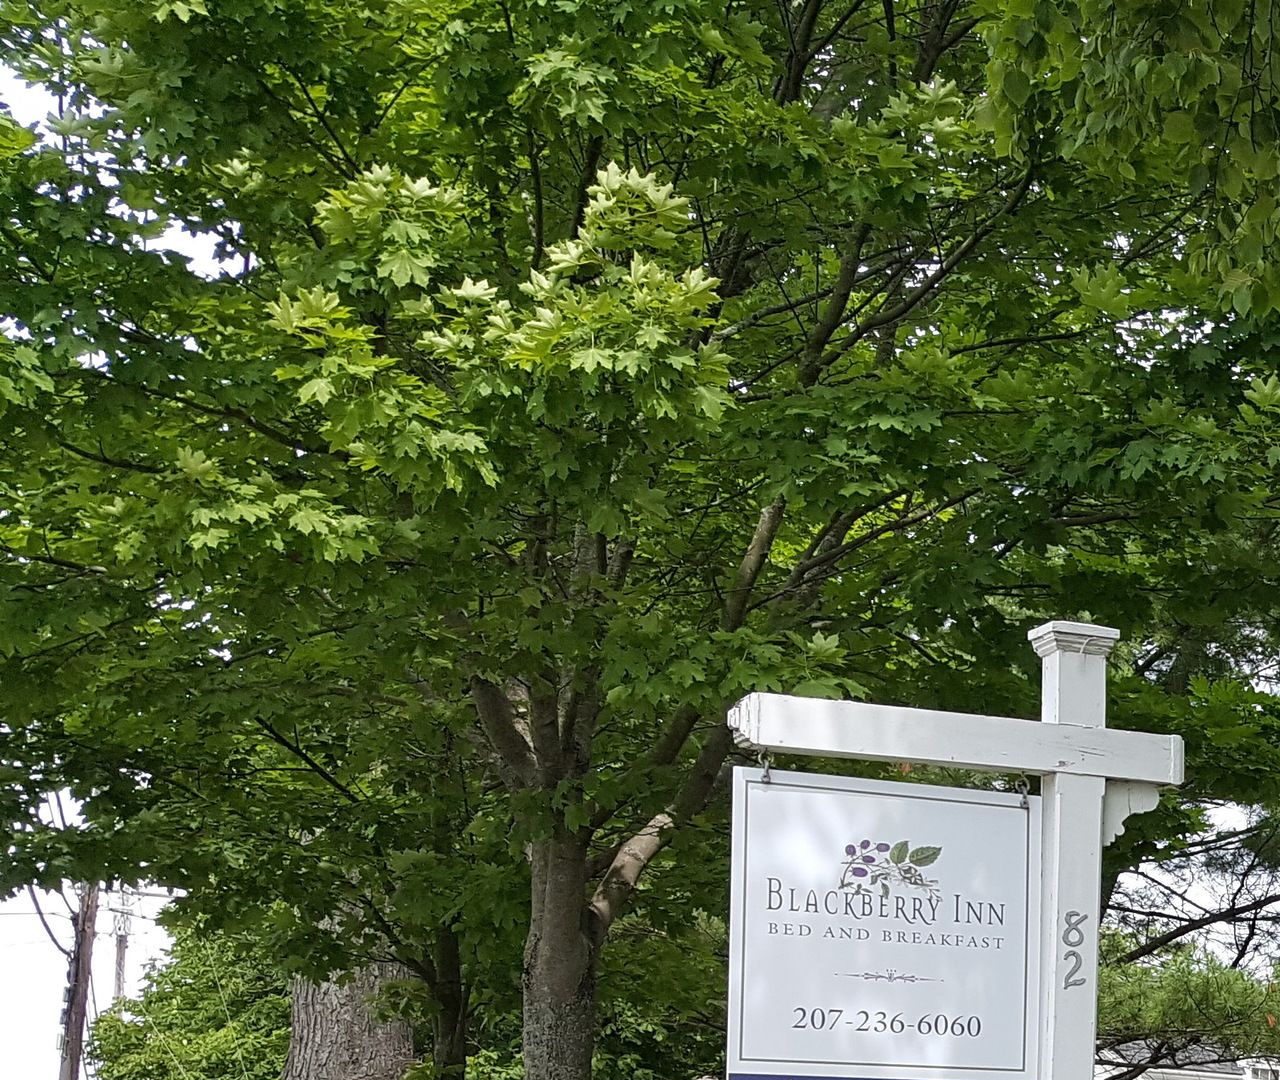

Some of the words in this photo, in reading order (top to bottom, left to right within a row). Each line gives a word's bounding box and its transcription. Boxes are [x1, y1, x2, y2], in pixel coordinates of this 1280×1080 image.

[765, 877, 941, 926] BLACKBERRY
[953, 894, 1005, 926] INN
[768, 922, 812, 936] BED
[823, 926, 870, 940] AND
[882, 930, 1004, 949] BREAKFAST
[1062, 910, 1088, 990] 82
[791, 1007, 982, 1037] 207-236-6060
